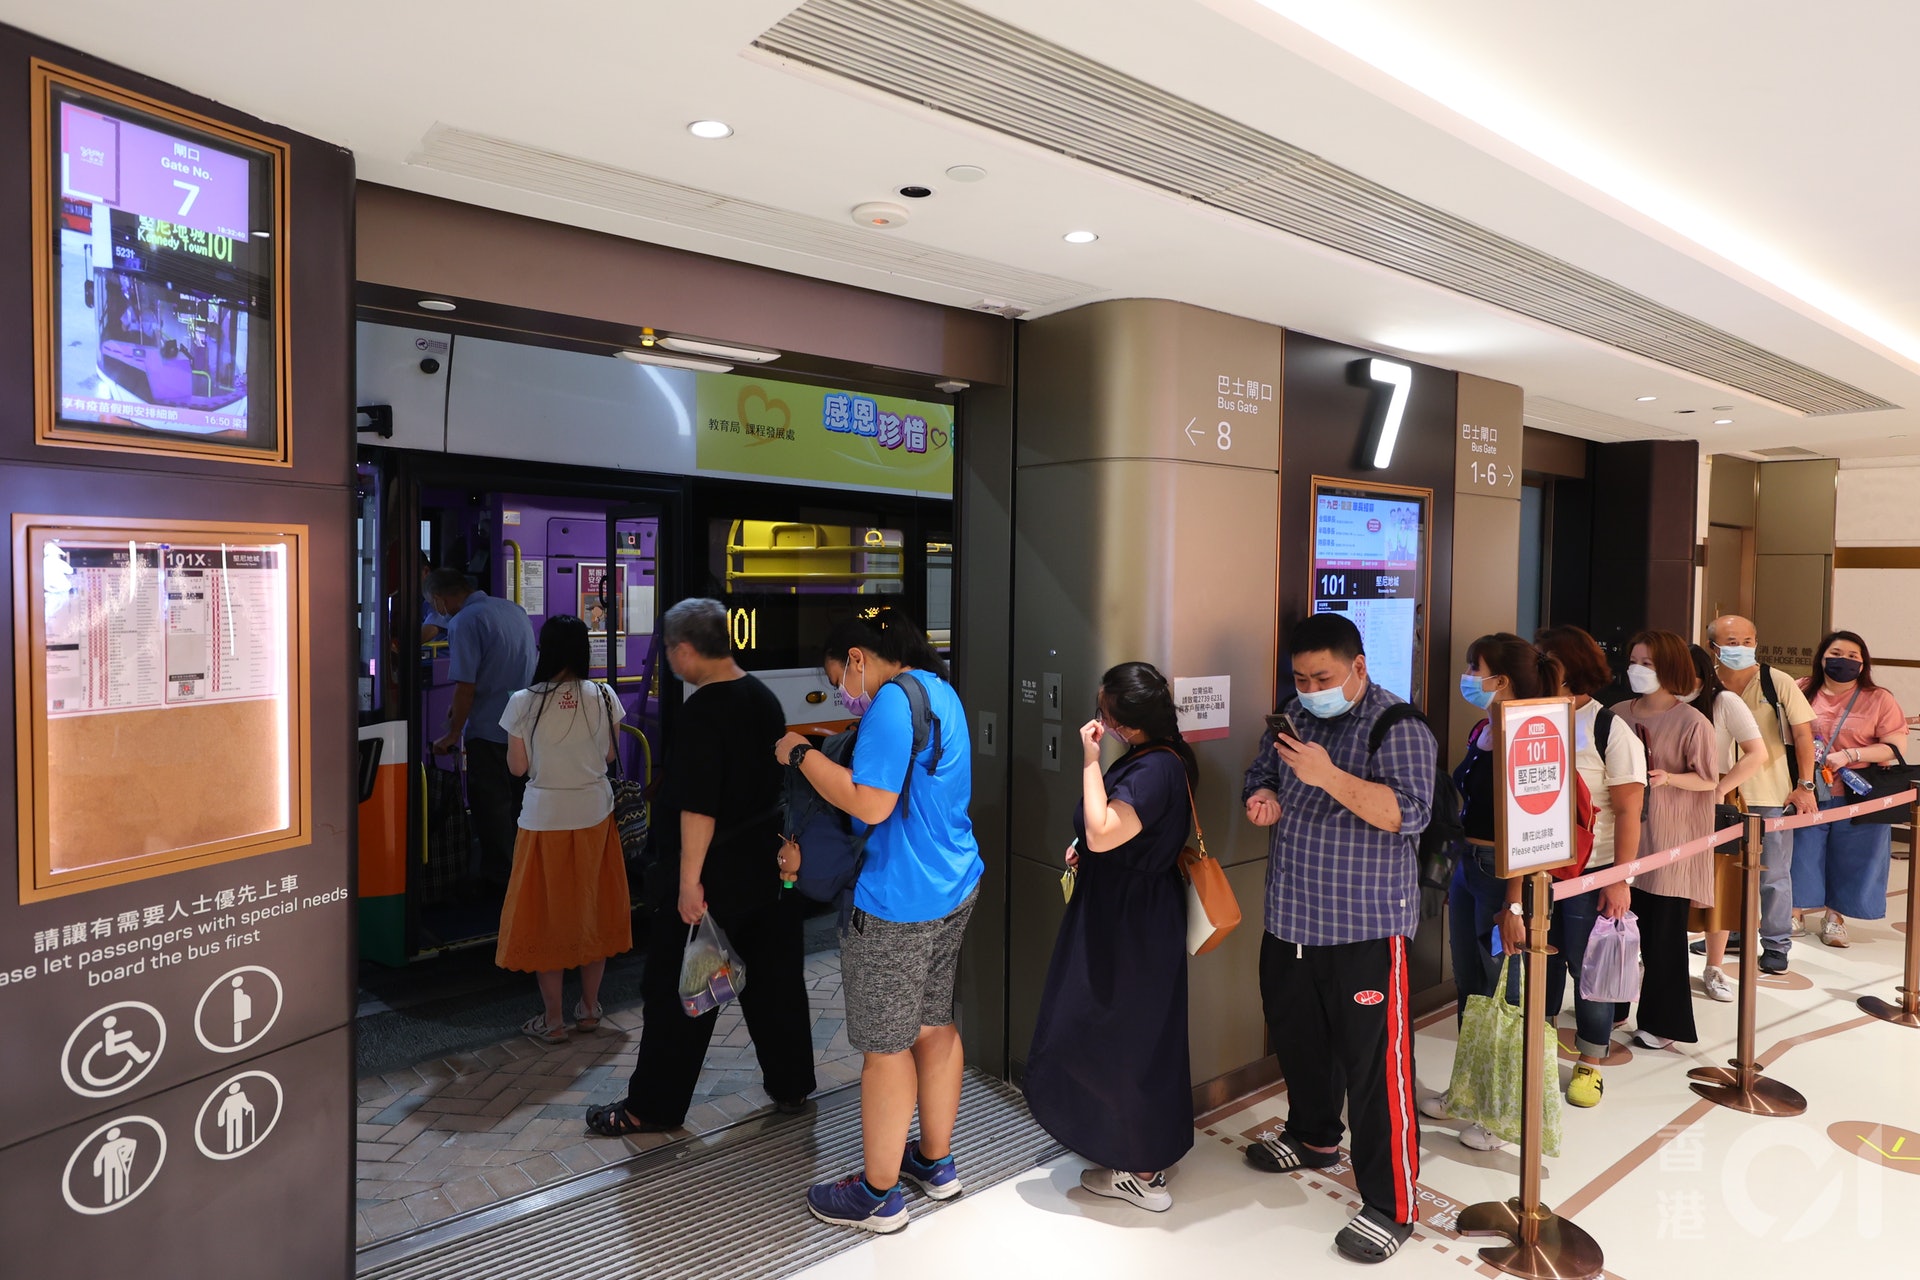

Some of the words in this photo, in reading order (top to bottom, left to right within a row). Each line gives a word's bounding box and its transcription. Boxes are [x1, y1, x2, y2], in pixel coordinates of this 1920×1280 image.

[174, 142, 200, 162] 閘口
[161, 156, 190, 174] Gate
[192, 165, 213, 181] No.
[173, 179, 200, 217] 7
[138, 228, 180, 251] Kennedy
[182, 237, 208, 257] Town
[1218, 375, 1272, 402] 巴士閘口
[1217, 396, 1235, 411] Bus
[1237, 399, 1258, 415] Gate
[1369, 358, 1412, 469] 7
[205, 415, 230, 427] 16:50
[708, 418, 741, 434] 教育局
[745, 423, 796, 441] 課程發展處
[823, 393, 928, 453] 感恩珍惜
[1217, 421, 1232, 451] 8
[1462, 423, 1497, 443] 巴士閘口
[1471, 442, 1483, 454] Bus
[1483, 443, 1497, 455] Gate
[1470, 461, 1497, 486] 1-6
[166, 553, 206, 567] 101X
[1321, 574, 1345, 596] 101
[1375, 575, 1400, 587] 堅尼地城
[1773, 656, 1794, 665] HOSE
[1527, 741, 1547, 762] 101
[1518, 765, 1557, 786] 堅尼地城
[1523, 785, 1539, 793] Kennedy
[1540, 783, 1551, 791] Town
[1522, 827, 1554, 842] 請在此排隊
[1511, 845, 1531, 857] Please
[1531, 842, 1550, 854] queue
[1550, 840, 1564, 850] here
[33, 874, 299, 954] 請讓有需要人士優先上車
[44, 954, 72, 975] let
[78, 926, 193, 970] passengers
[198, 914, 236, 935] with
[241, 897, 298, 926] special
[303, 887, 348, 909] needs
[88, 957, 145, 987] board
[150, 952, 182, 969] the
[188, 942, 220, 960] bus
[225, 930, 261, 950] first
